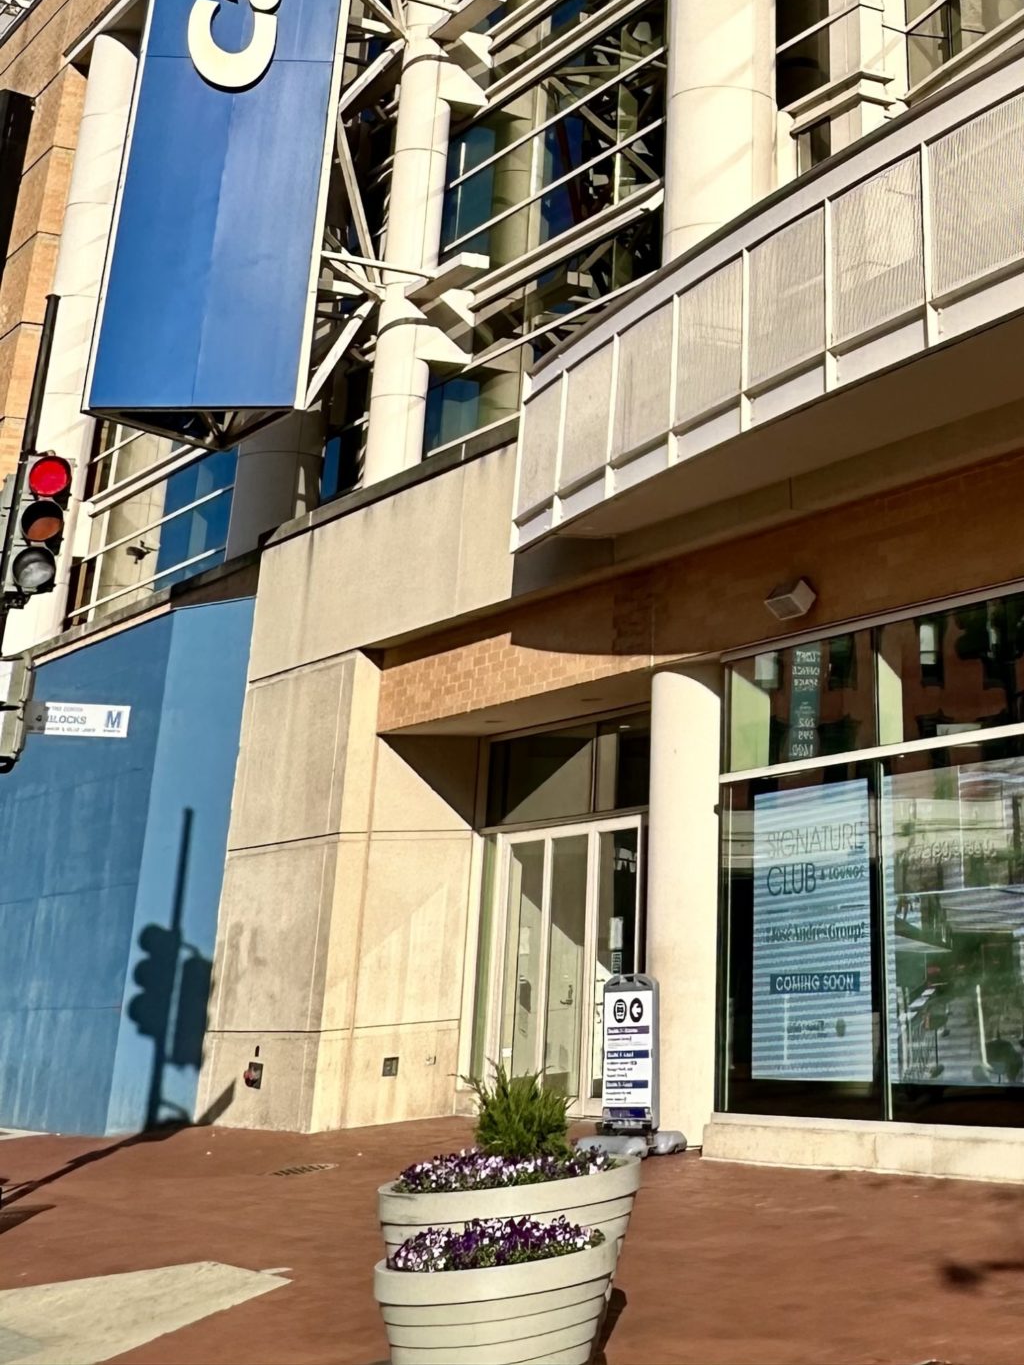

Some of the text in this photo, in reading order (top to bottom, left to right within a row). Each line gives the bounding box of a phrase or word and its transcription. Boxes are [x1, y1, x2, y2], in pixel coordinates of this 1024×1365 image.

[766, 821, 866, 858] SIGNATURE
[766, 862, 817, 896] CLUB
[775, 973, 854, 992] COMING SOON
